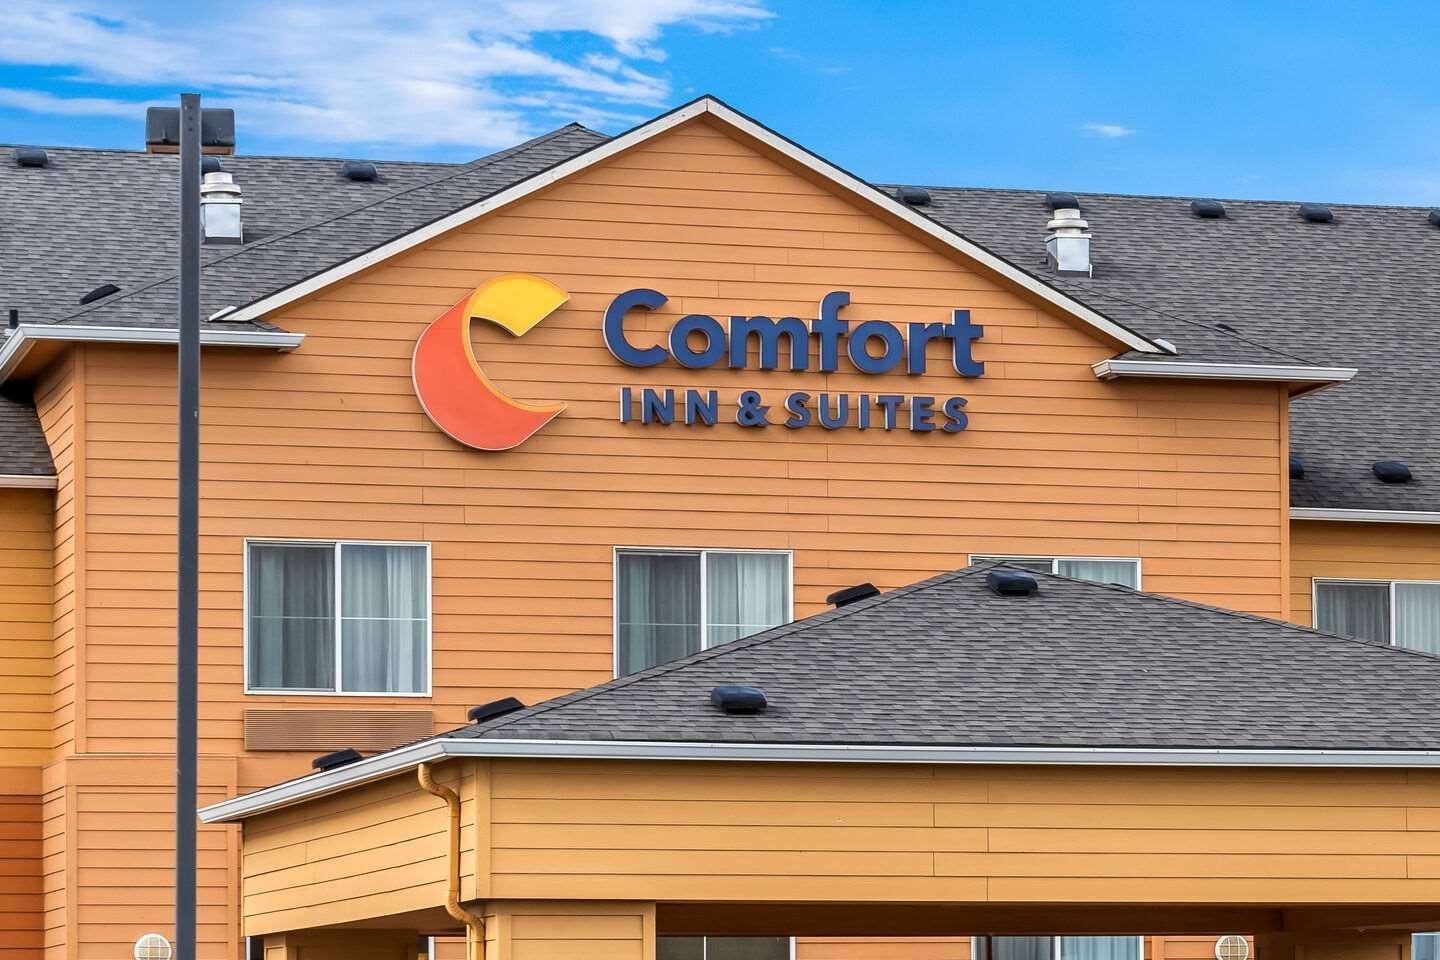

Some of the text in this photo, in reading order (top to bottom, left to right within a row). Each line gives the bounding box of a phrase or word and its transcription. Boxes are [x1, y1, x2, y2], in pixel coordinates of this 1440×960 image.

[603, 288, 985, 378] Comfort
[620, 387, 969, 433] INN & SUITES
